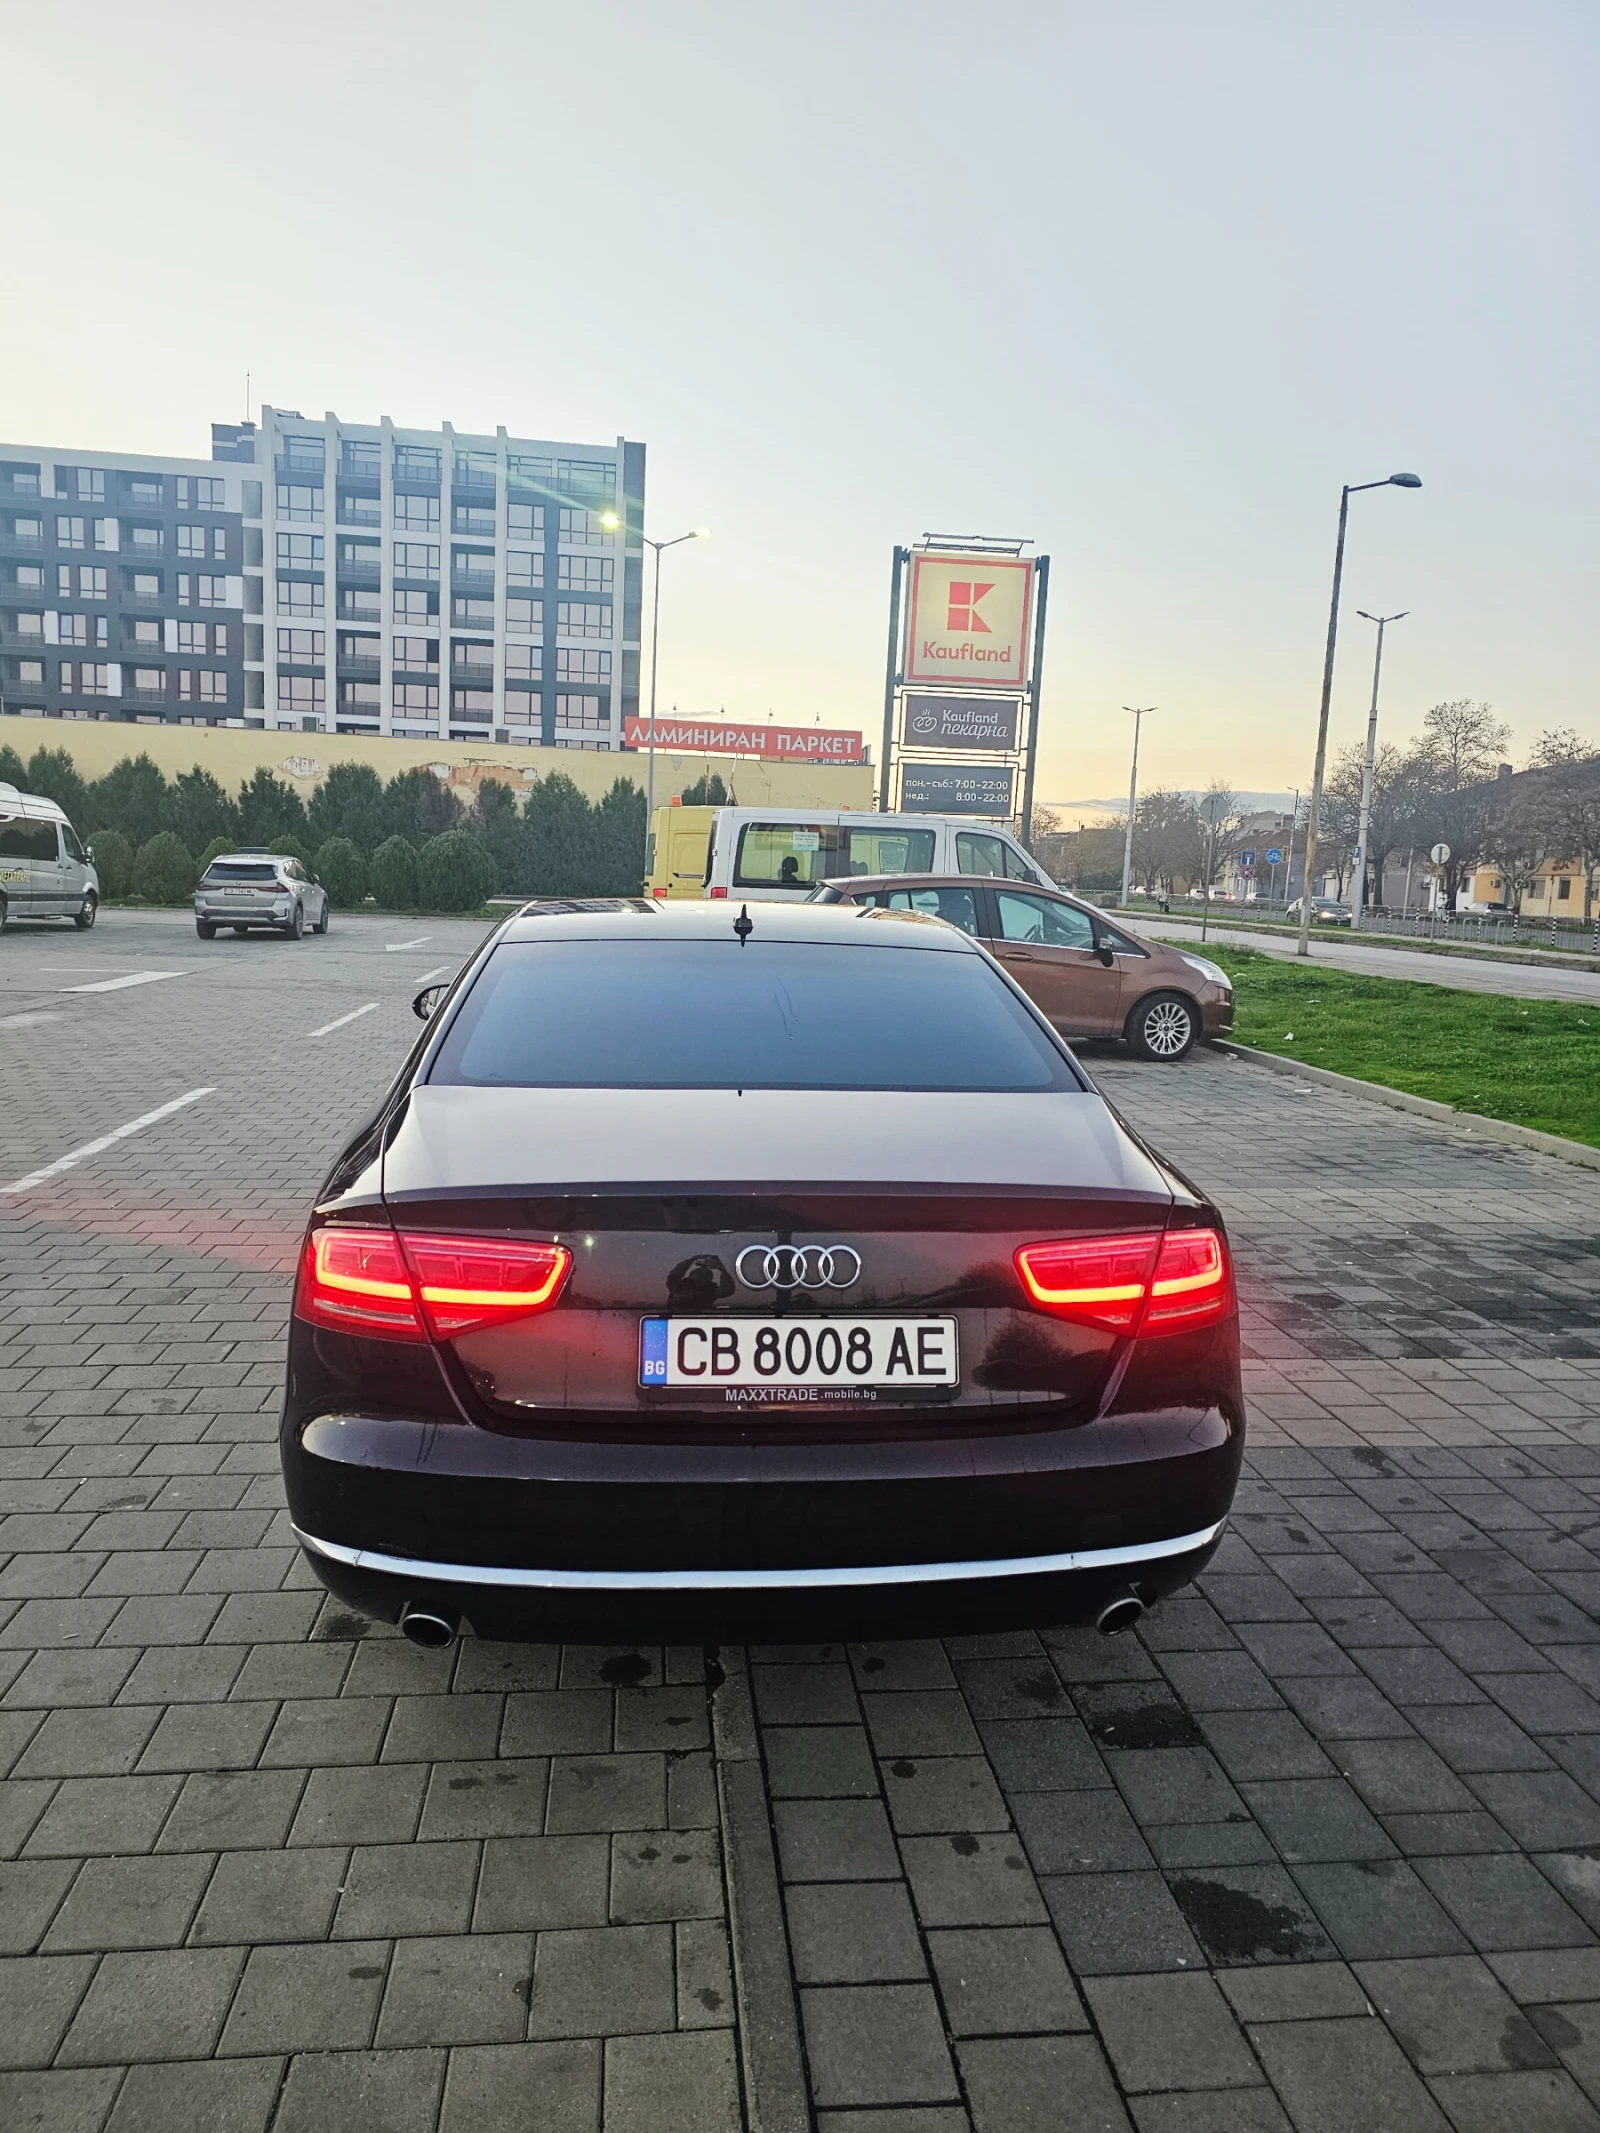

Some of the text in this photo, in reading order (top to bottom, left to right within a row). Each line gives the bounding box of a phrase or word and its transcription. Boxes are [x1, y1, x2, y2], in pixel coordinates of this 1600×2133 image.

[922, 641, 1011, 663] Kaufland
[942, 709, 998, 724] Kaufland
[630, 725, 856, 754] ЛАМИНИРАН ПАРКЕТ
[940, 723, 1009, 740] пекарна
[955, 779, 1008, 790] 7:00-22:00
[905, 792, 1010, 803] нед.: 8:00-22:00
[677, 1326, 947, 1376] CB 8008 AE
[644, 1360, 665, 1376] BG
